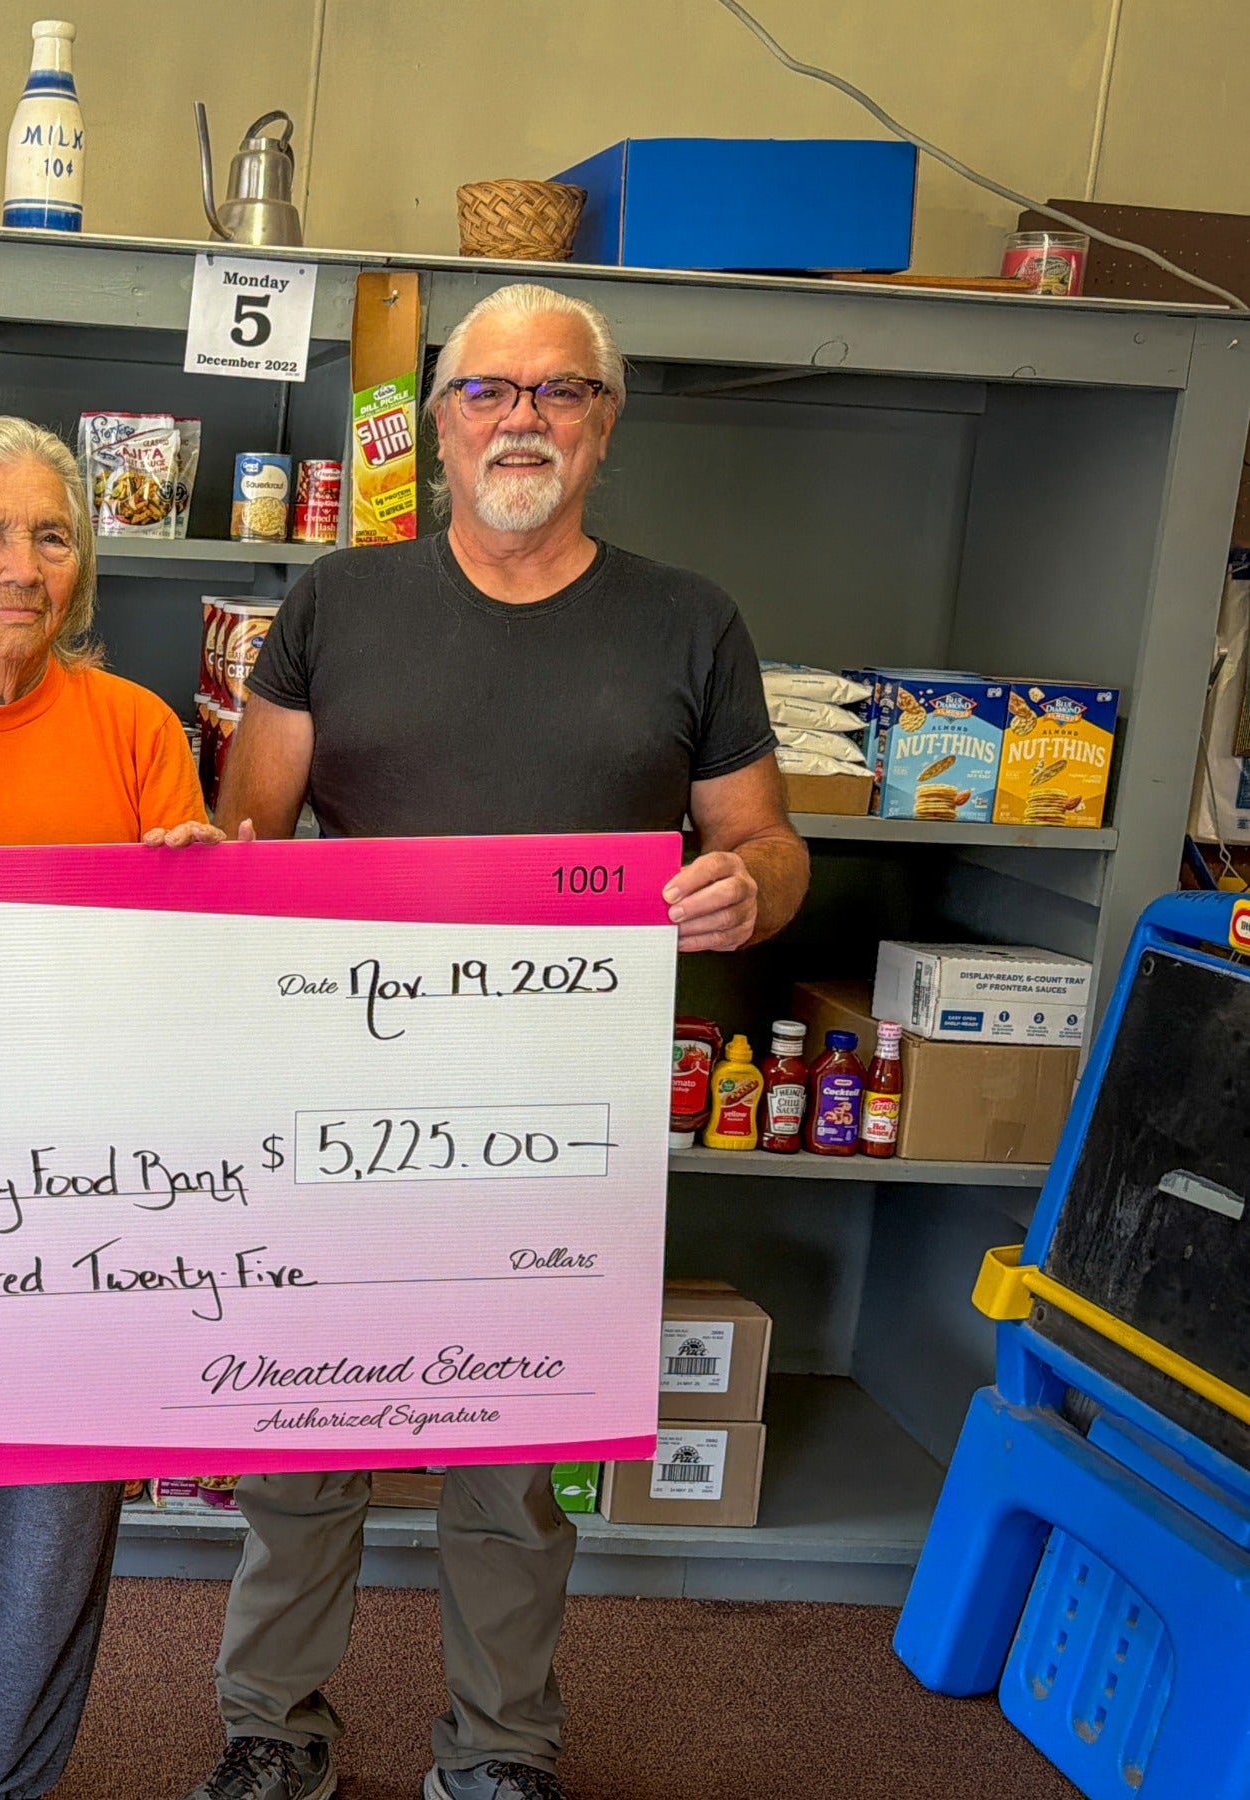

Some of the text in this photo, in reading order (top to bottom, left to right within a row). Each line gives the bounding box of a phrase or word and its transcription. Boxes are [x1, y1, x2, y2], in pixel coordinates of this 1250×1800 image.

[20, 124, 84, 151] MILK
[44, 157, 73, 178] 10¢
[222, 271, 290, 293] Monday
[230, 294, 272, 348] 5
[196, 353, 298, 372] December 2022
[360, 390, 409, 415] DILL PICKLE
[245, 480, 284, 490] Sauerkraut
[896, 733, 996, 764] NUT-THINS
[1007, 737, 1106, 768] NUT-THINS
[551, 865, 625, 894] 1001
[277, 973, 339, 997] Date
[960, 971, 1024, 983] DISPLAY-READY,
[1064, 977, 1086, 985] TRAY
[976, 983, 1067, 994] OF FRONTERA SAUCES
[350, 958, 427, 1040] Nov.
[779, 1087, 801, 1096] HEINZ
[823, 1087, 861, 1097] Cocktail
[723, 1110, 748, 1118] yellow
[261, 1133, 285, 1173] $
[30, 1146, 119, 1197] Food
[133, 1149, 249, 1211] Bank
[509, 1247, 598, 1271] Dollars
[201, 1344, 566, 1395] Wheatland Electric
[253, 1404, 501, 1436] Authorized Signature
